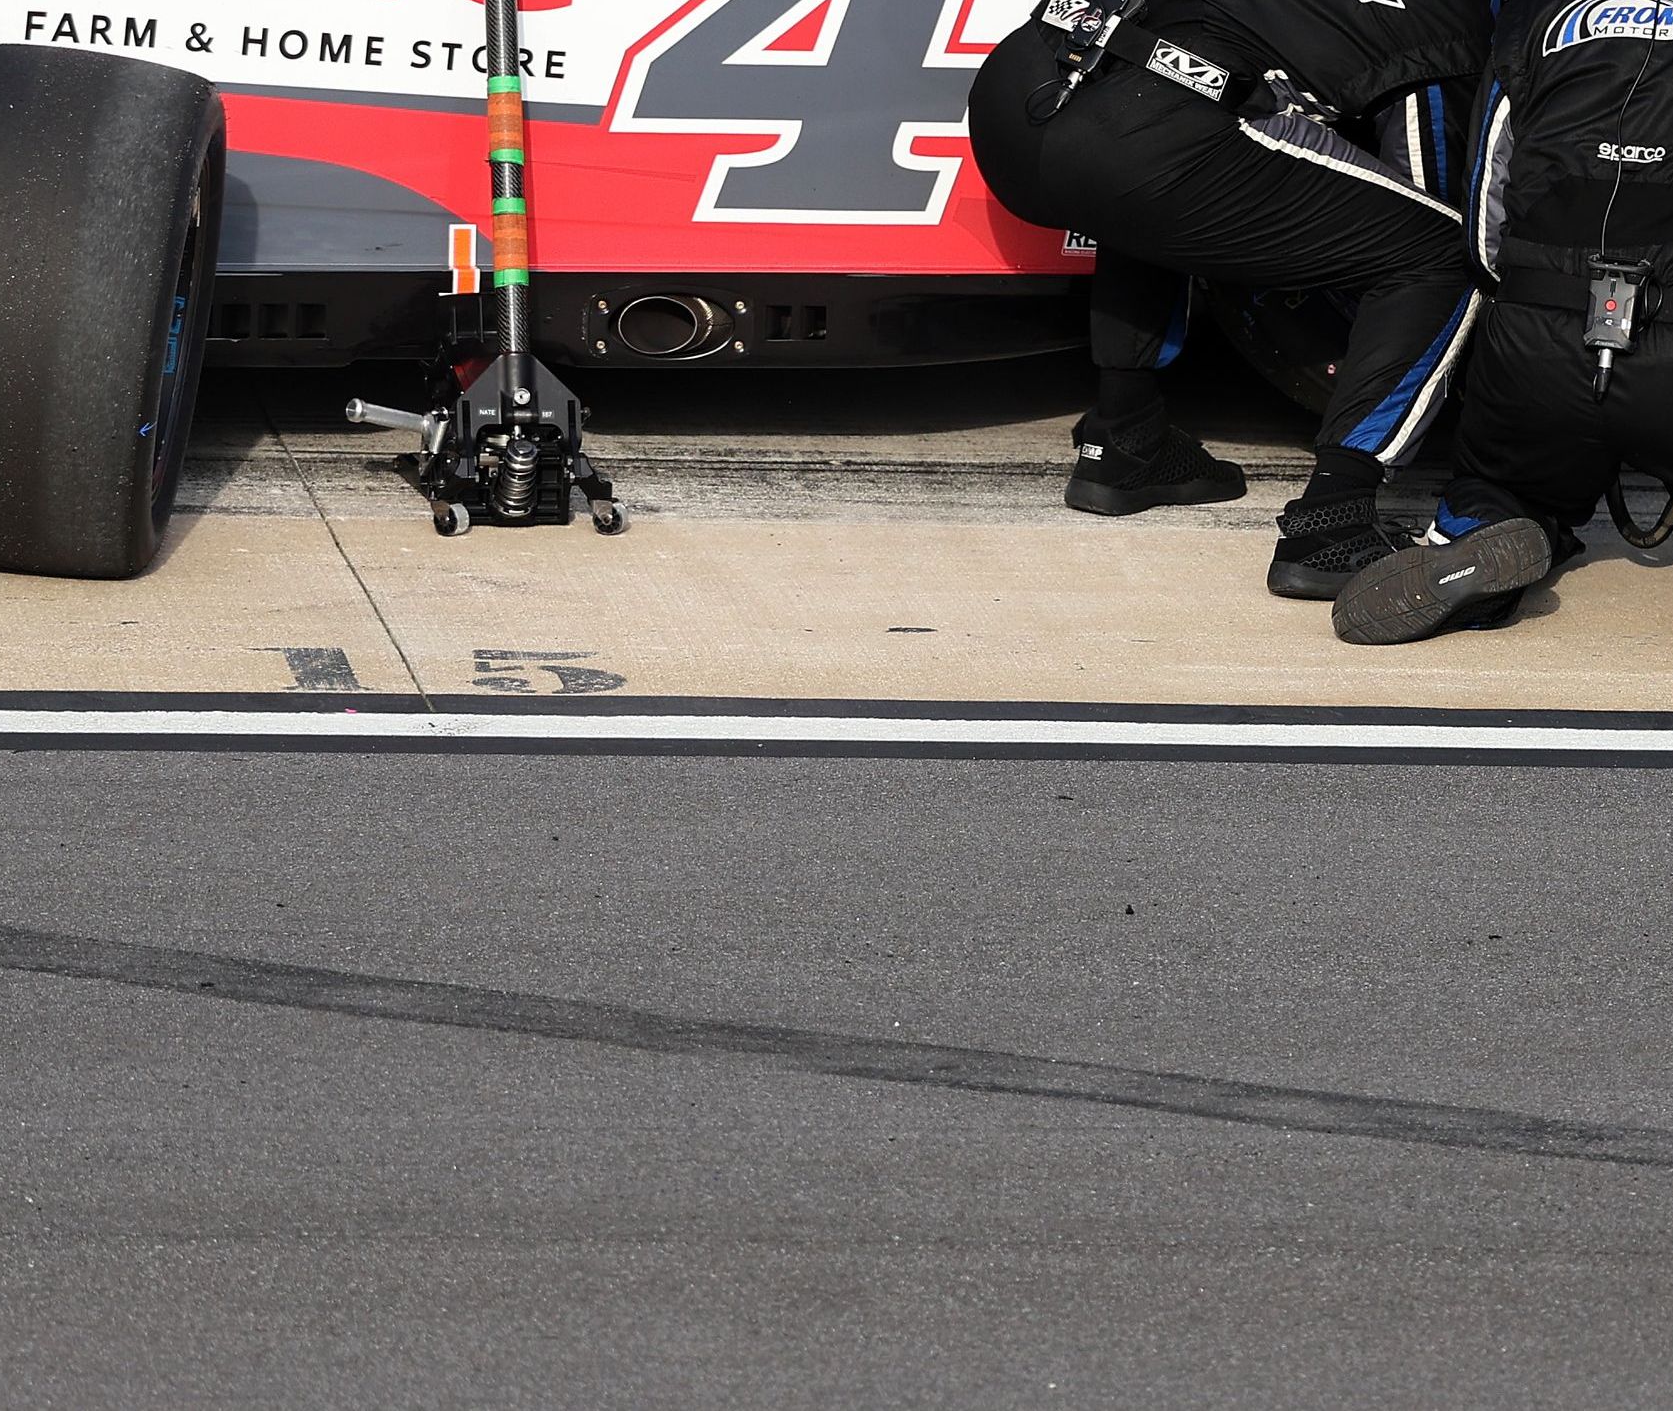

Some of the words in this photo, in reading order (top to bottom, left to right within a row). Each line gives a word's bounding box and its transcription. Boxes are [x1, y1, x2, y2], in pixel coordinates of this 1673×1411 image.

[24, 11, 158, 50] FARM
[184, 21, 216, 55] &
[240, 26, 385, 67] HOME
[479, 409, 497, 417] NATE
[1438, 565, 1477, 587] OMP
